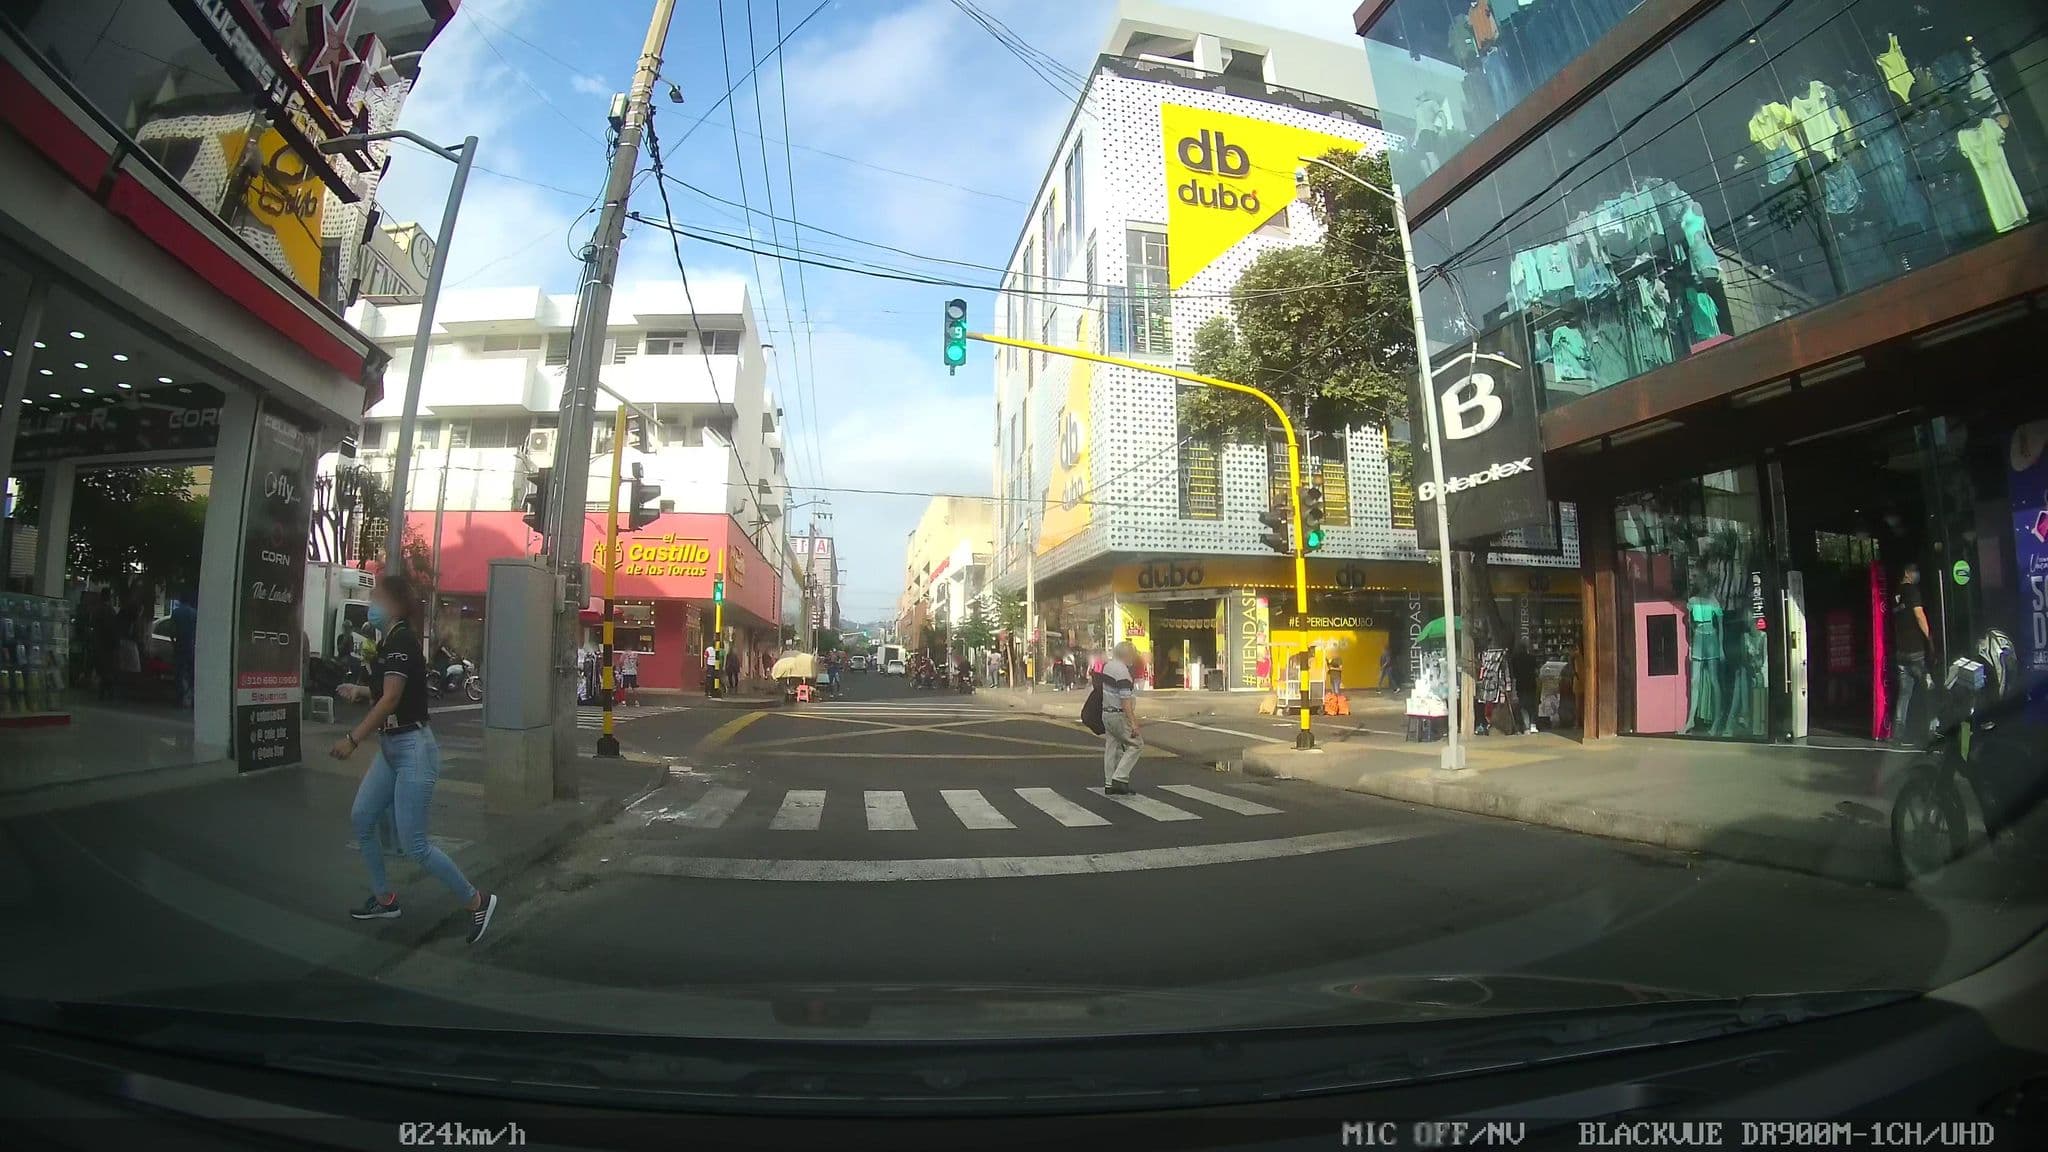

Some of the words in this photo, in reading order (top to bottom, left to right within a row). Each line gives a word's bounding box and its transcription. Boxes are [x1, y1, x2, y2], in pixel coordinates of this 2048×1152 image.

[1177, 129, 1251, 179] db
[1440, 372, 1503, 440] B
[1059, 412, 1079, 471] db
[261, 550, 290, 566] CORN
[628, 544, 711, 564] Castillo
[626, 563, 643, 576] de
[646, 564, 665, 576] las
[667, 565, 708, 577] Tortas
[1289, 616, 1374, 628] #EPERIENCIADUBO
[252, 630, 289, 646] PRO
